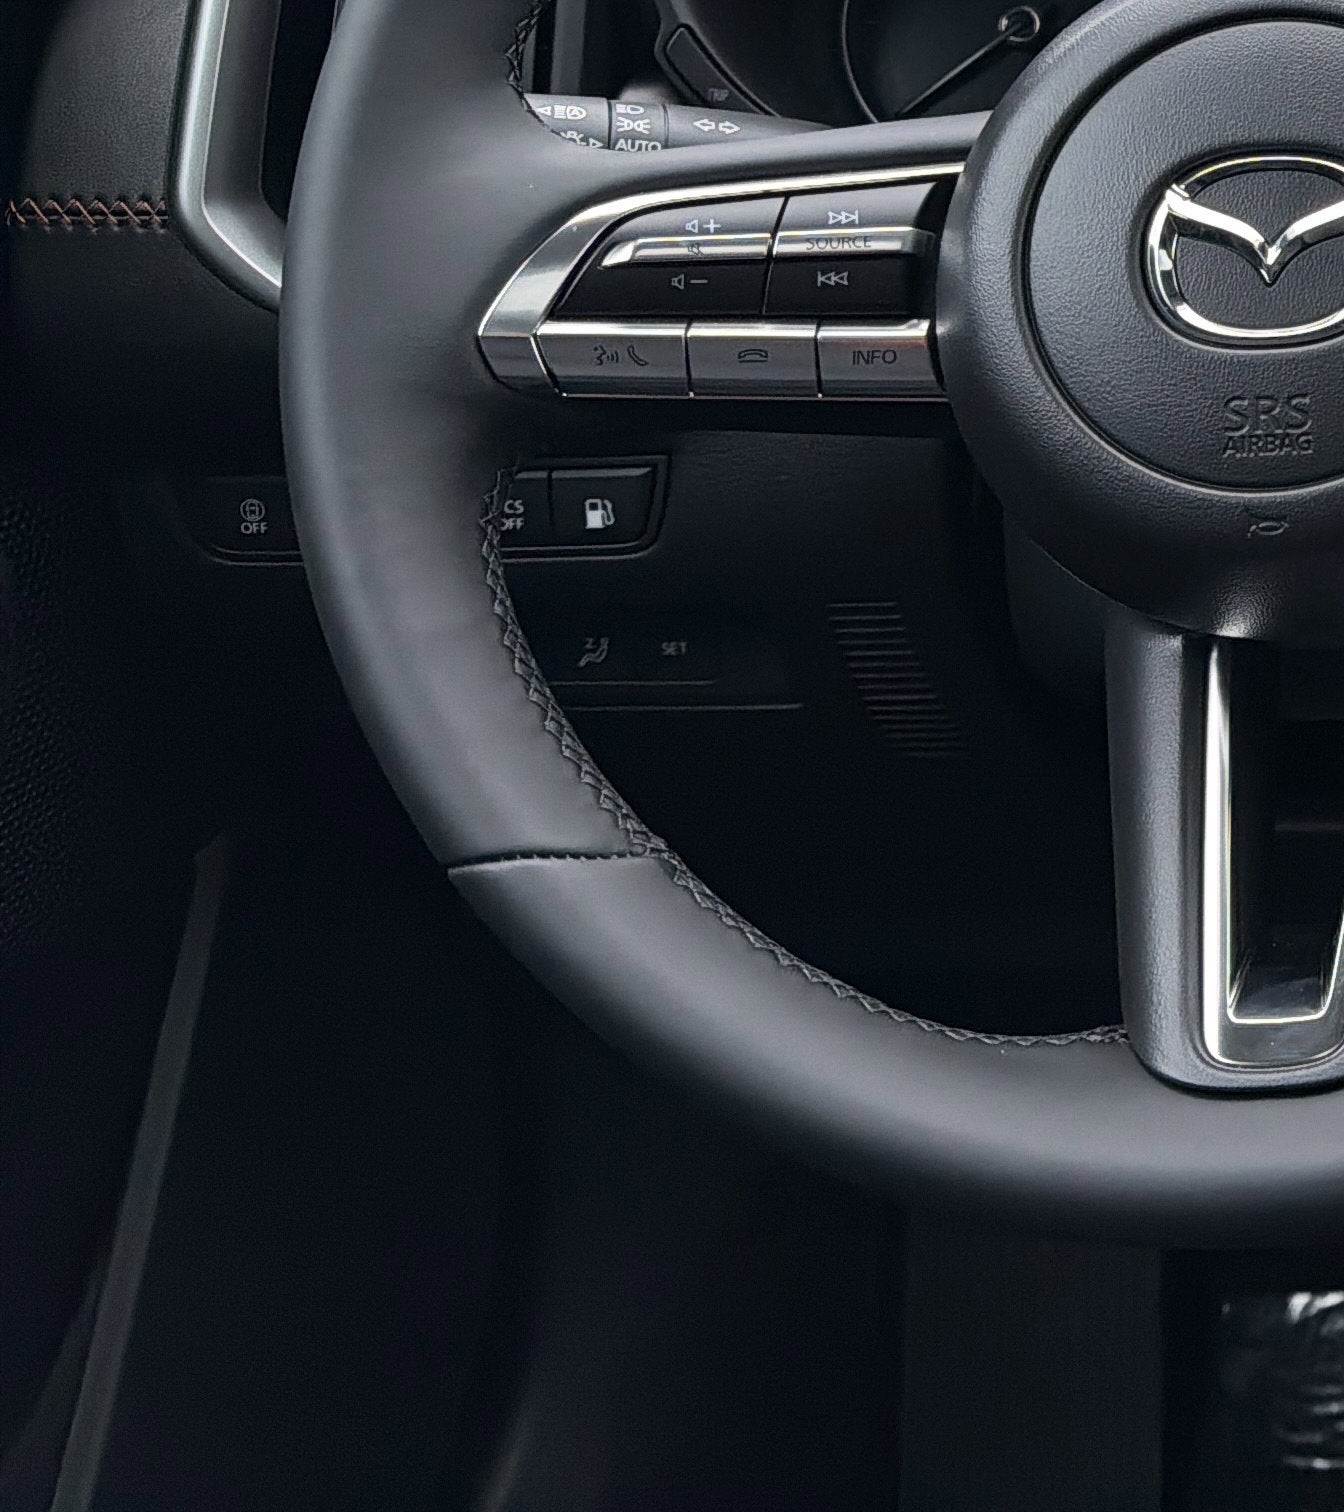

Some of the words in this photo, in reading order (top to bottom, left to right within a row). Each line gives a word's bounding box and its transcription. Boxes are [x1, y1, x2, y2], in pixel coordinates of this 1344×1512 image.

[614, 138, 662, 152] AUTO
[805, 234, 873, 251] SOURCE
[851, 349, 898, 366] INFO
[1221, 393, 1313, 435] SRS
[1220, 434, 1315, 459] AIRBAG
[502, 498, 525, 515] CS
[240, 521, 269, 535] OFF
[661, 641, 688, 656] SET
